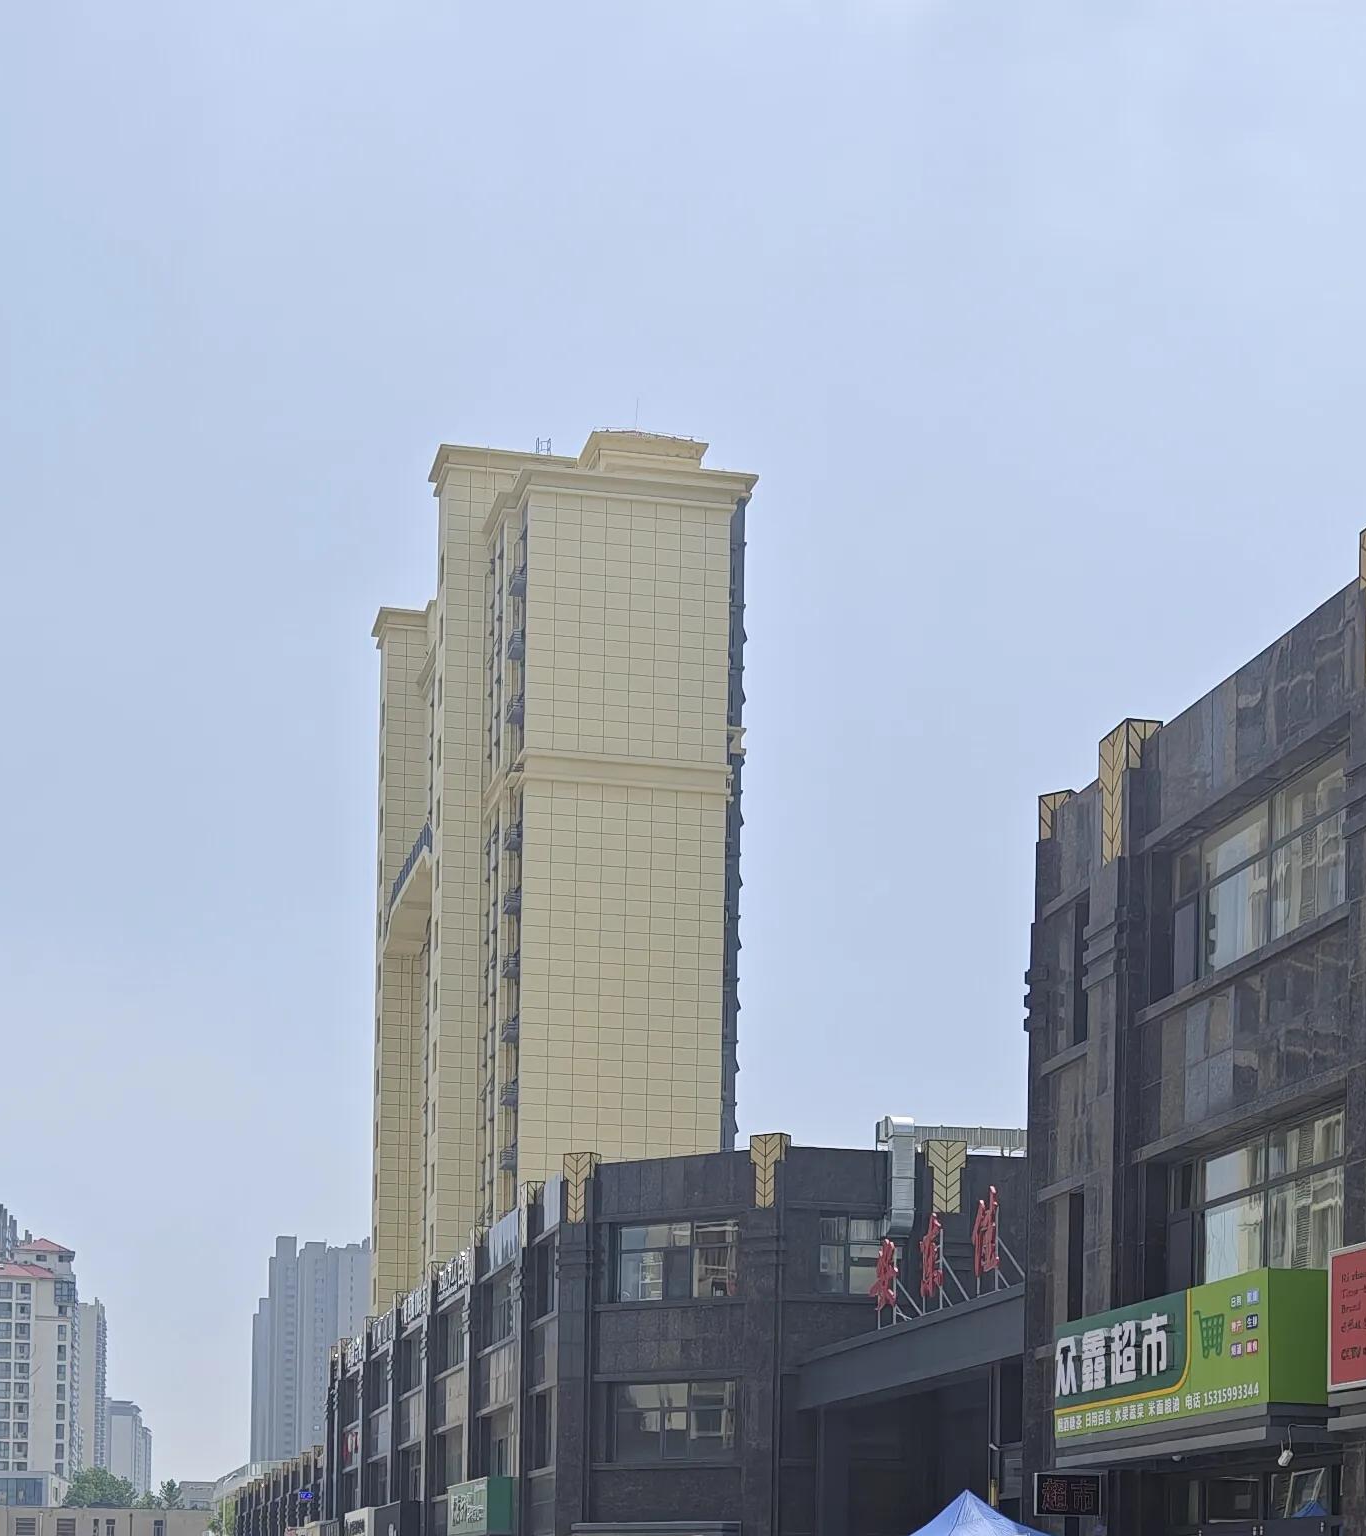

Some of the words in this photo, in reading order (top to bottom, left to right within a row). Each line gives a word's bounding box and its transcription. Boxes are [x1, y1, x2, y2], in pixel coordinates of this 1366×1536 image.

[1055, 1312, 1168, 1398] 众鑫超市
[1185, 1391, 1201, 1410] 电话
